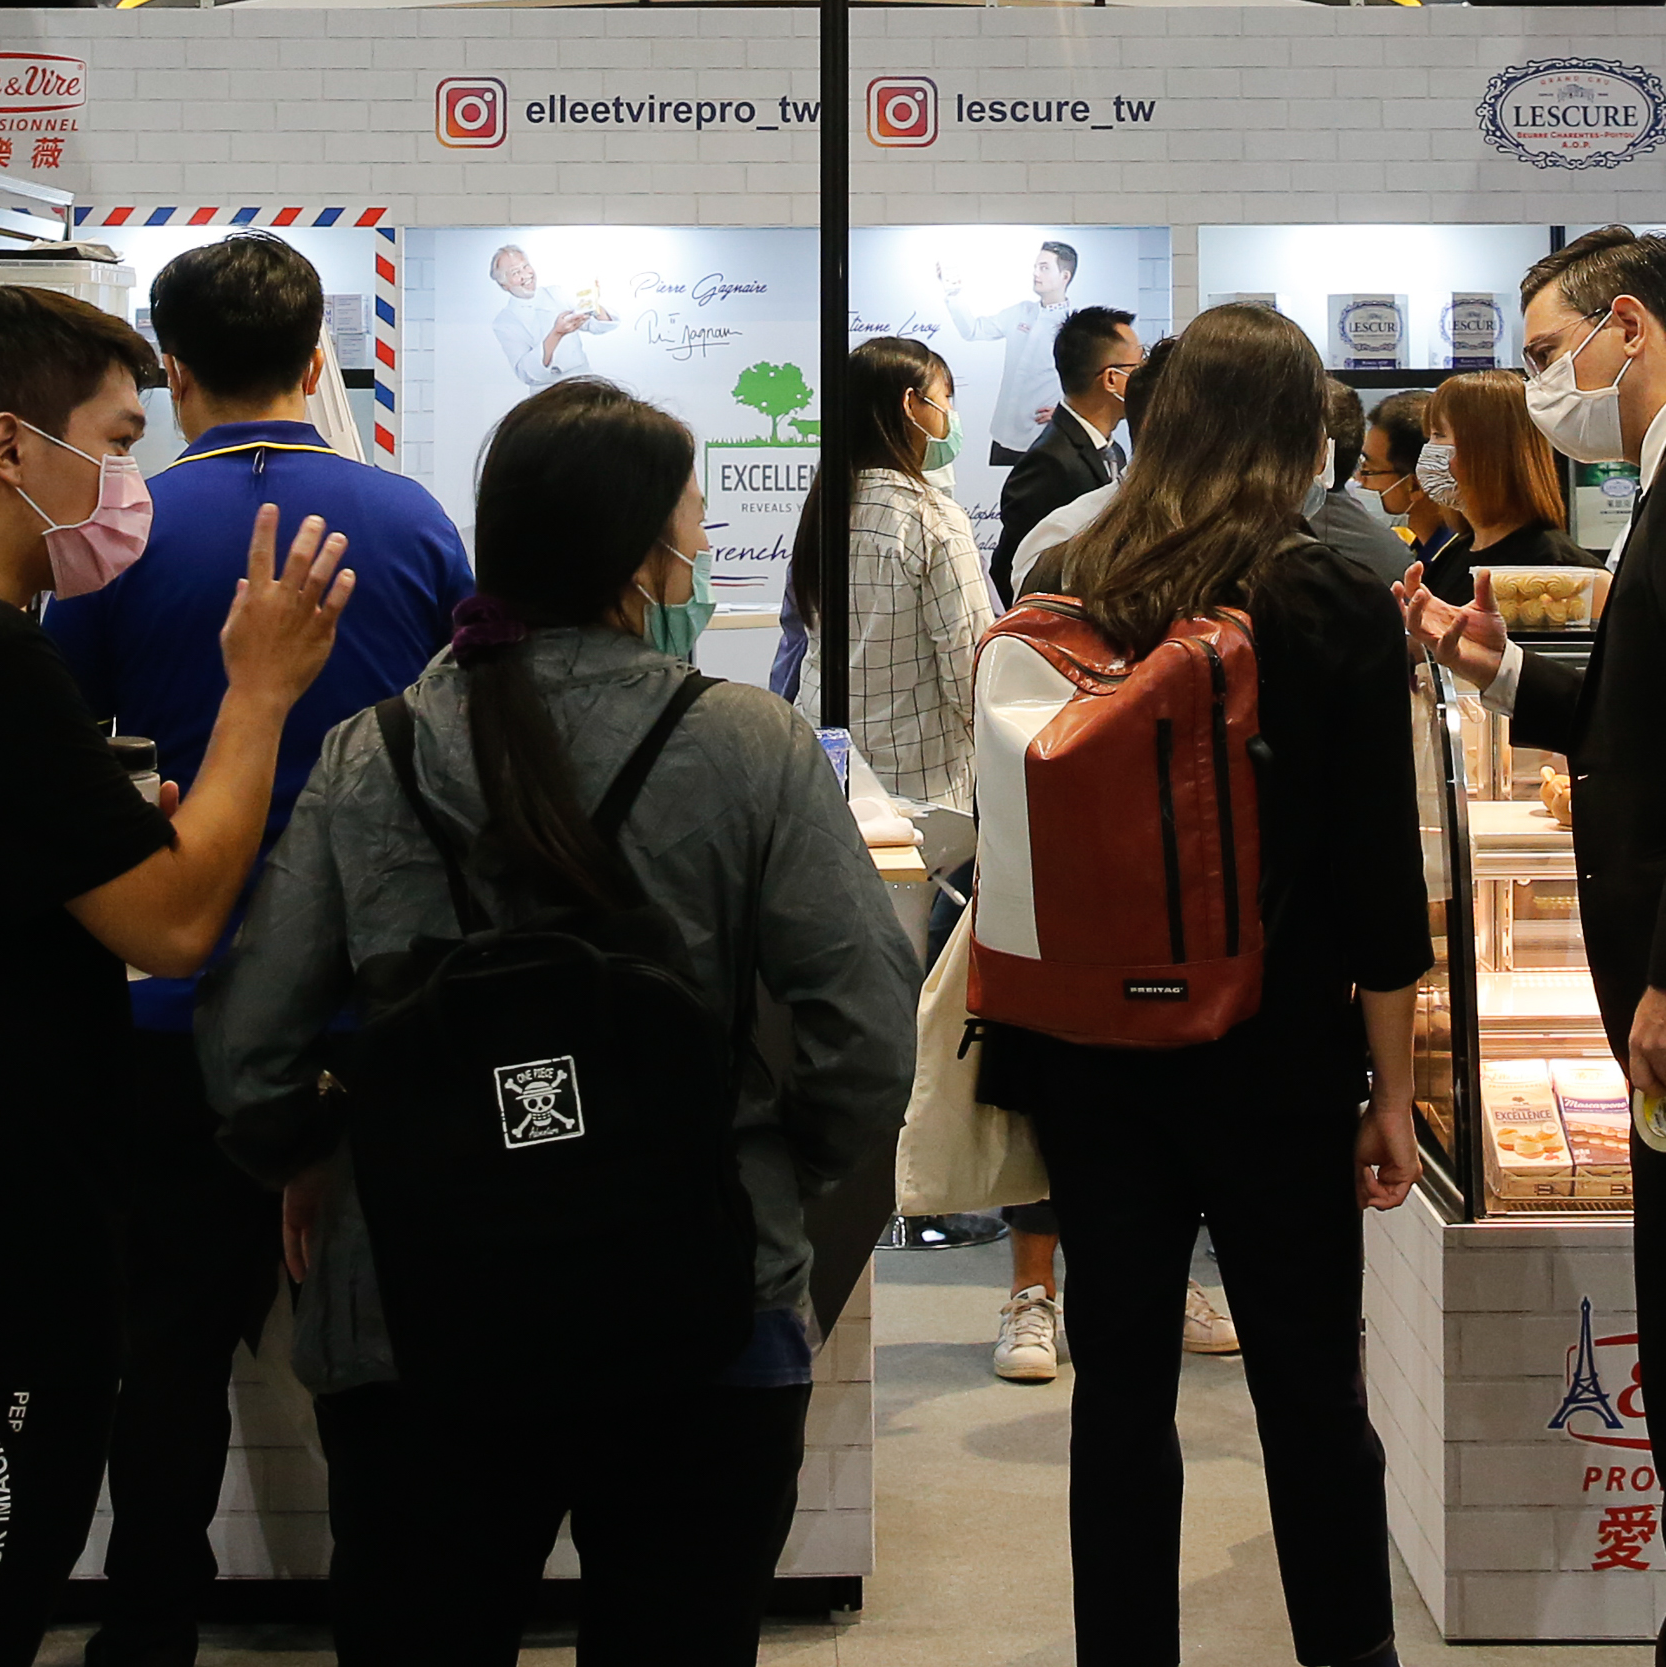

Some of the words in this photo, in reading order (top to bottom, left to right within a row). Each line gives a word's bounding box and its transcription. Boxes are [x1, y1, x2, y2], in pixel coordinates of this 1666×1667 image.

[1540, 76, 1580, 85] GRAND
[1588, 76, 1610, 85] CRU
[525, 94, 820, 133] elleetvirepro_tw
[957, 94, 1156, 132] lescure_tw
[1514, 105, 1638, 127] LESCURE
[848, 310, 892, 334] tienne
[741, 503, 792, 513] REVEALS
[1564, 1098, 1627, 1111] Mascarpone
[1495, 1109, 1552, 1121] EXCELLENCE
